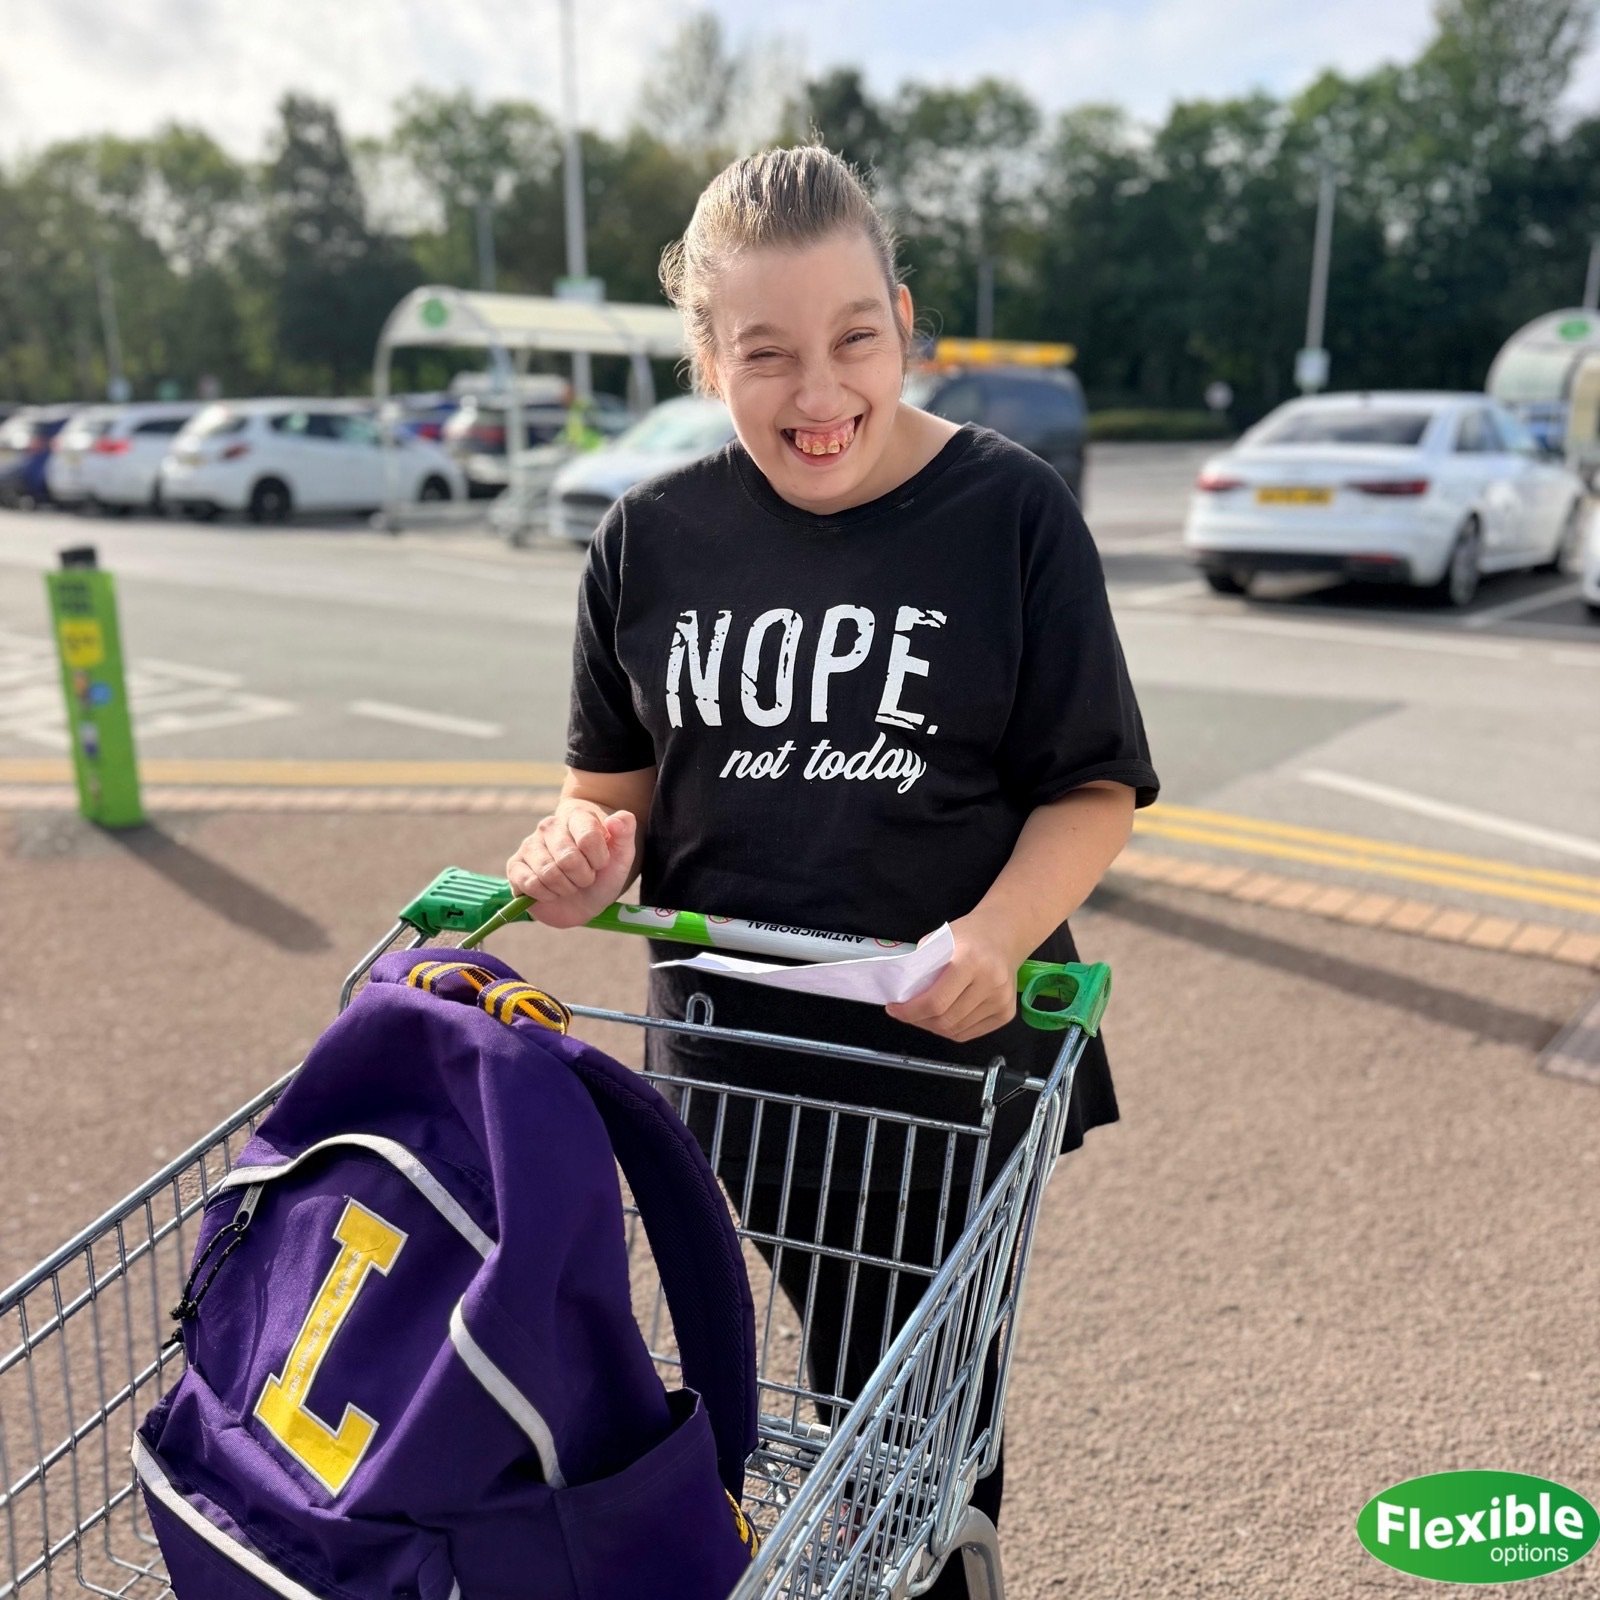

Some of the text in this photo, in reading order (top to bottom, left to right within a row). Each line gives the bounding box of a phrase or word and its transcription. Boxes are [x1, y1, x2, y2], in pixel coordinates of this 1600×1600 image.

[666, 604, 948, 735] NOPE.
[719, 732, 927, 794] not today
[747, 920, 867, 944] ANTIMICROBIAL
[254, 1198, 409, 1497] L
